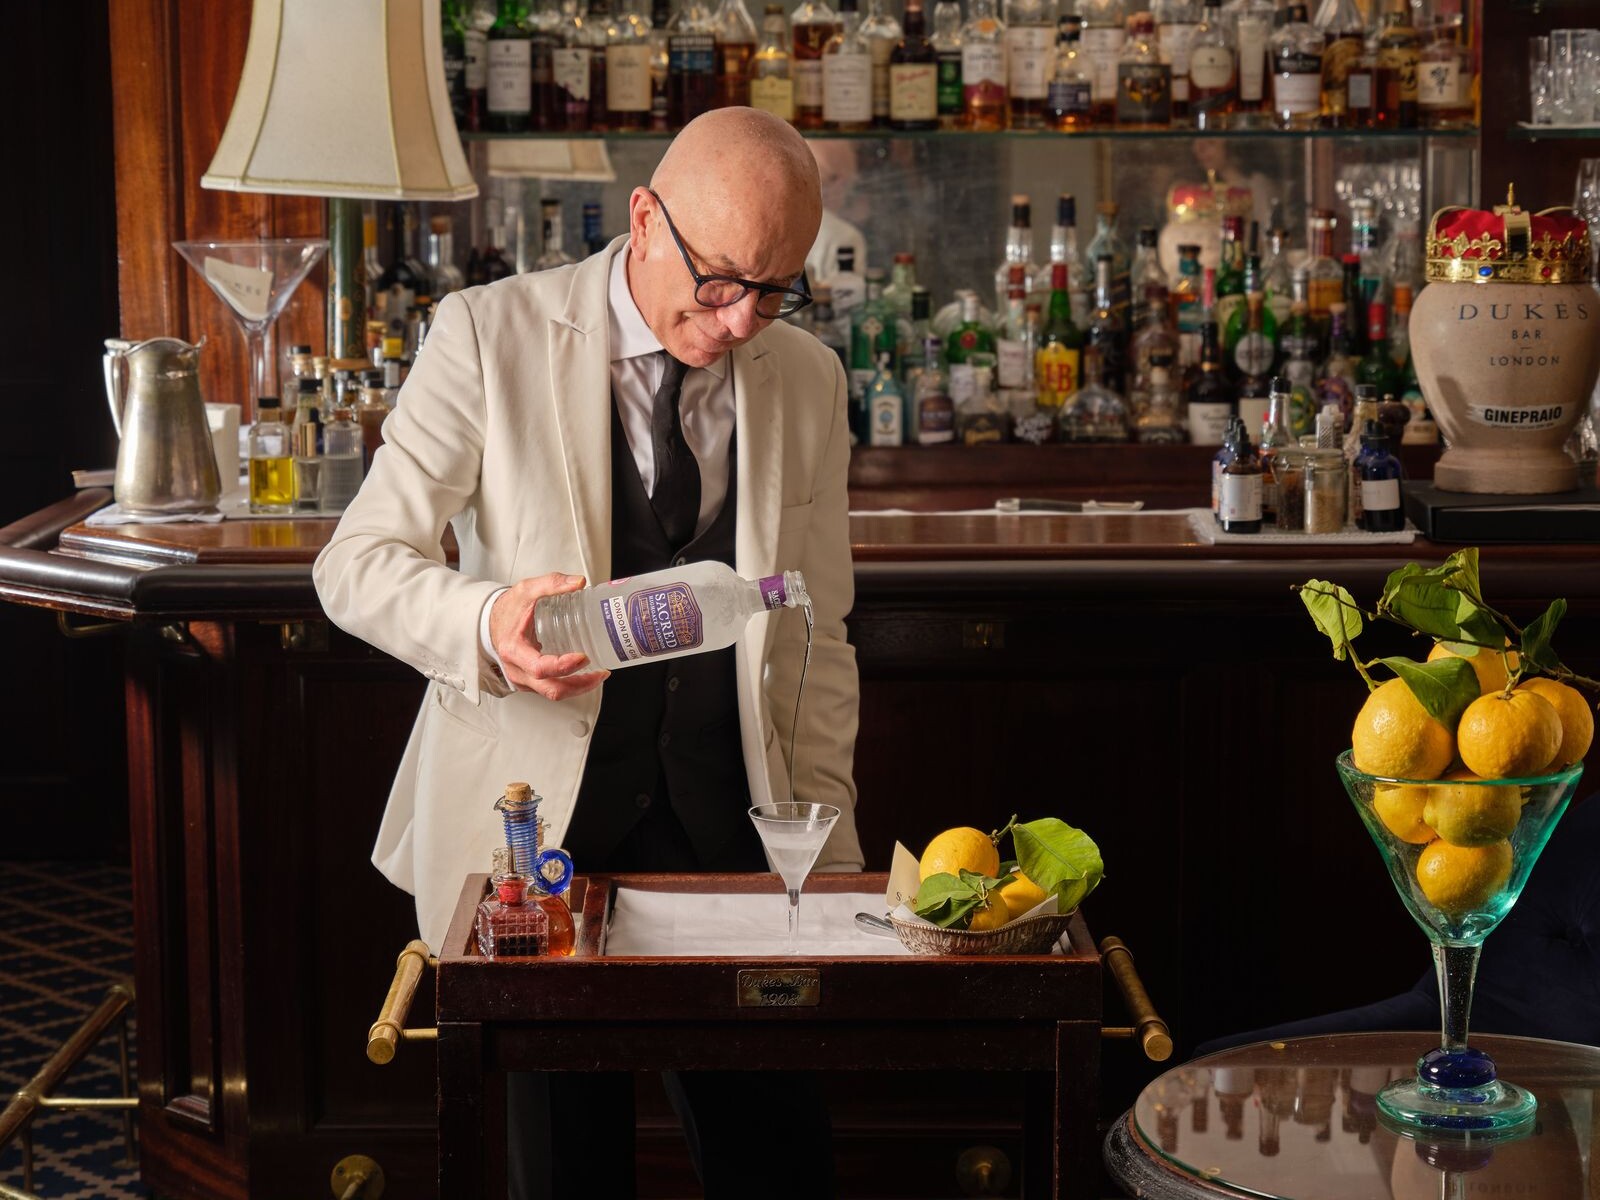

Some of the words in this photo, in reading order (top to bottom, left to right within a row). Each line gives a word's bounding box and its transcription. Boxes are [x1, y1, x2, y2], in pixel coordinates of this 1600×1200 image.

[1457, 303, 1588, 321] DUKES
[1511, 329, 1542, 340] BAR
[1489, 355, 1560, 366] LONDON
[1484, 406, 1562, 424] GINEPRAIO
[612, 597, 628, 633] LONDON
[622, 632, 634, 650] DRY
[654, 592, 678, 648] SACRED
[741, 974, 782, 988] Dukes
[790, 974, 818, 987] Bar
[761, 992, 800, 1007] 1908
